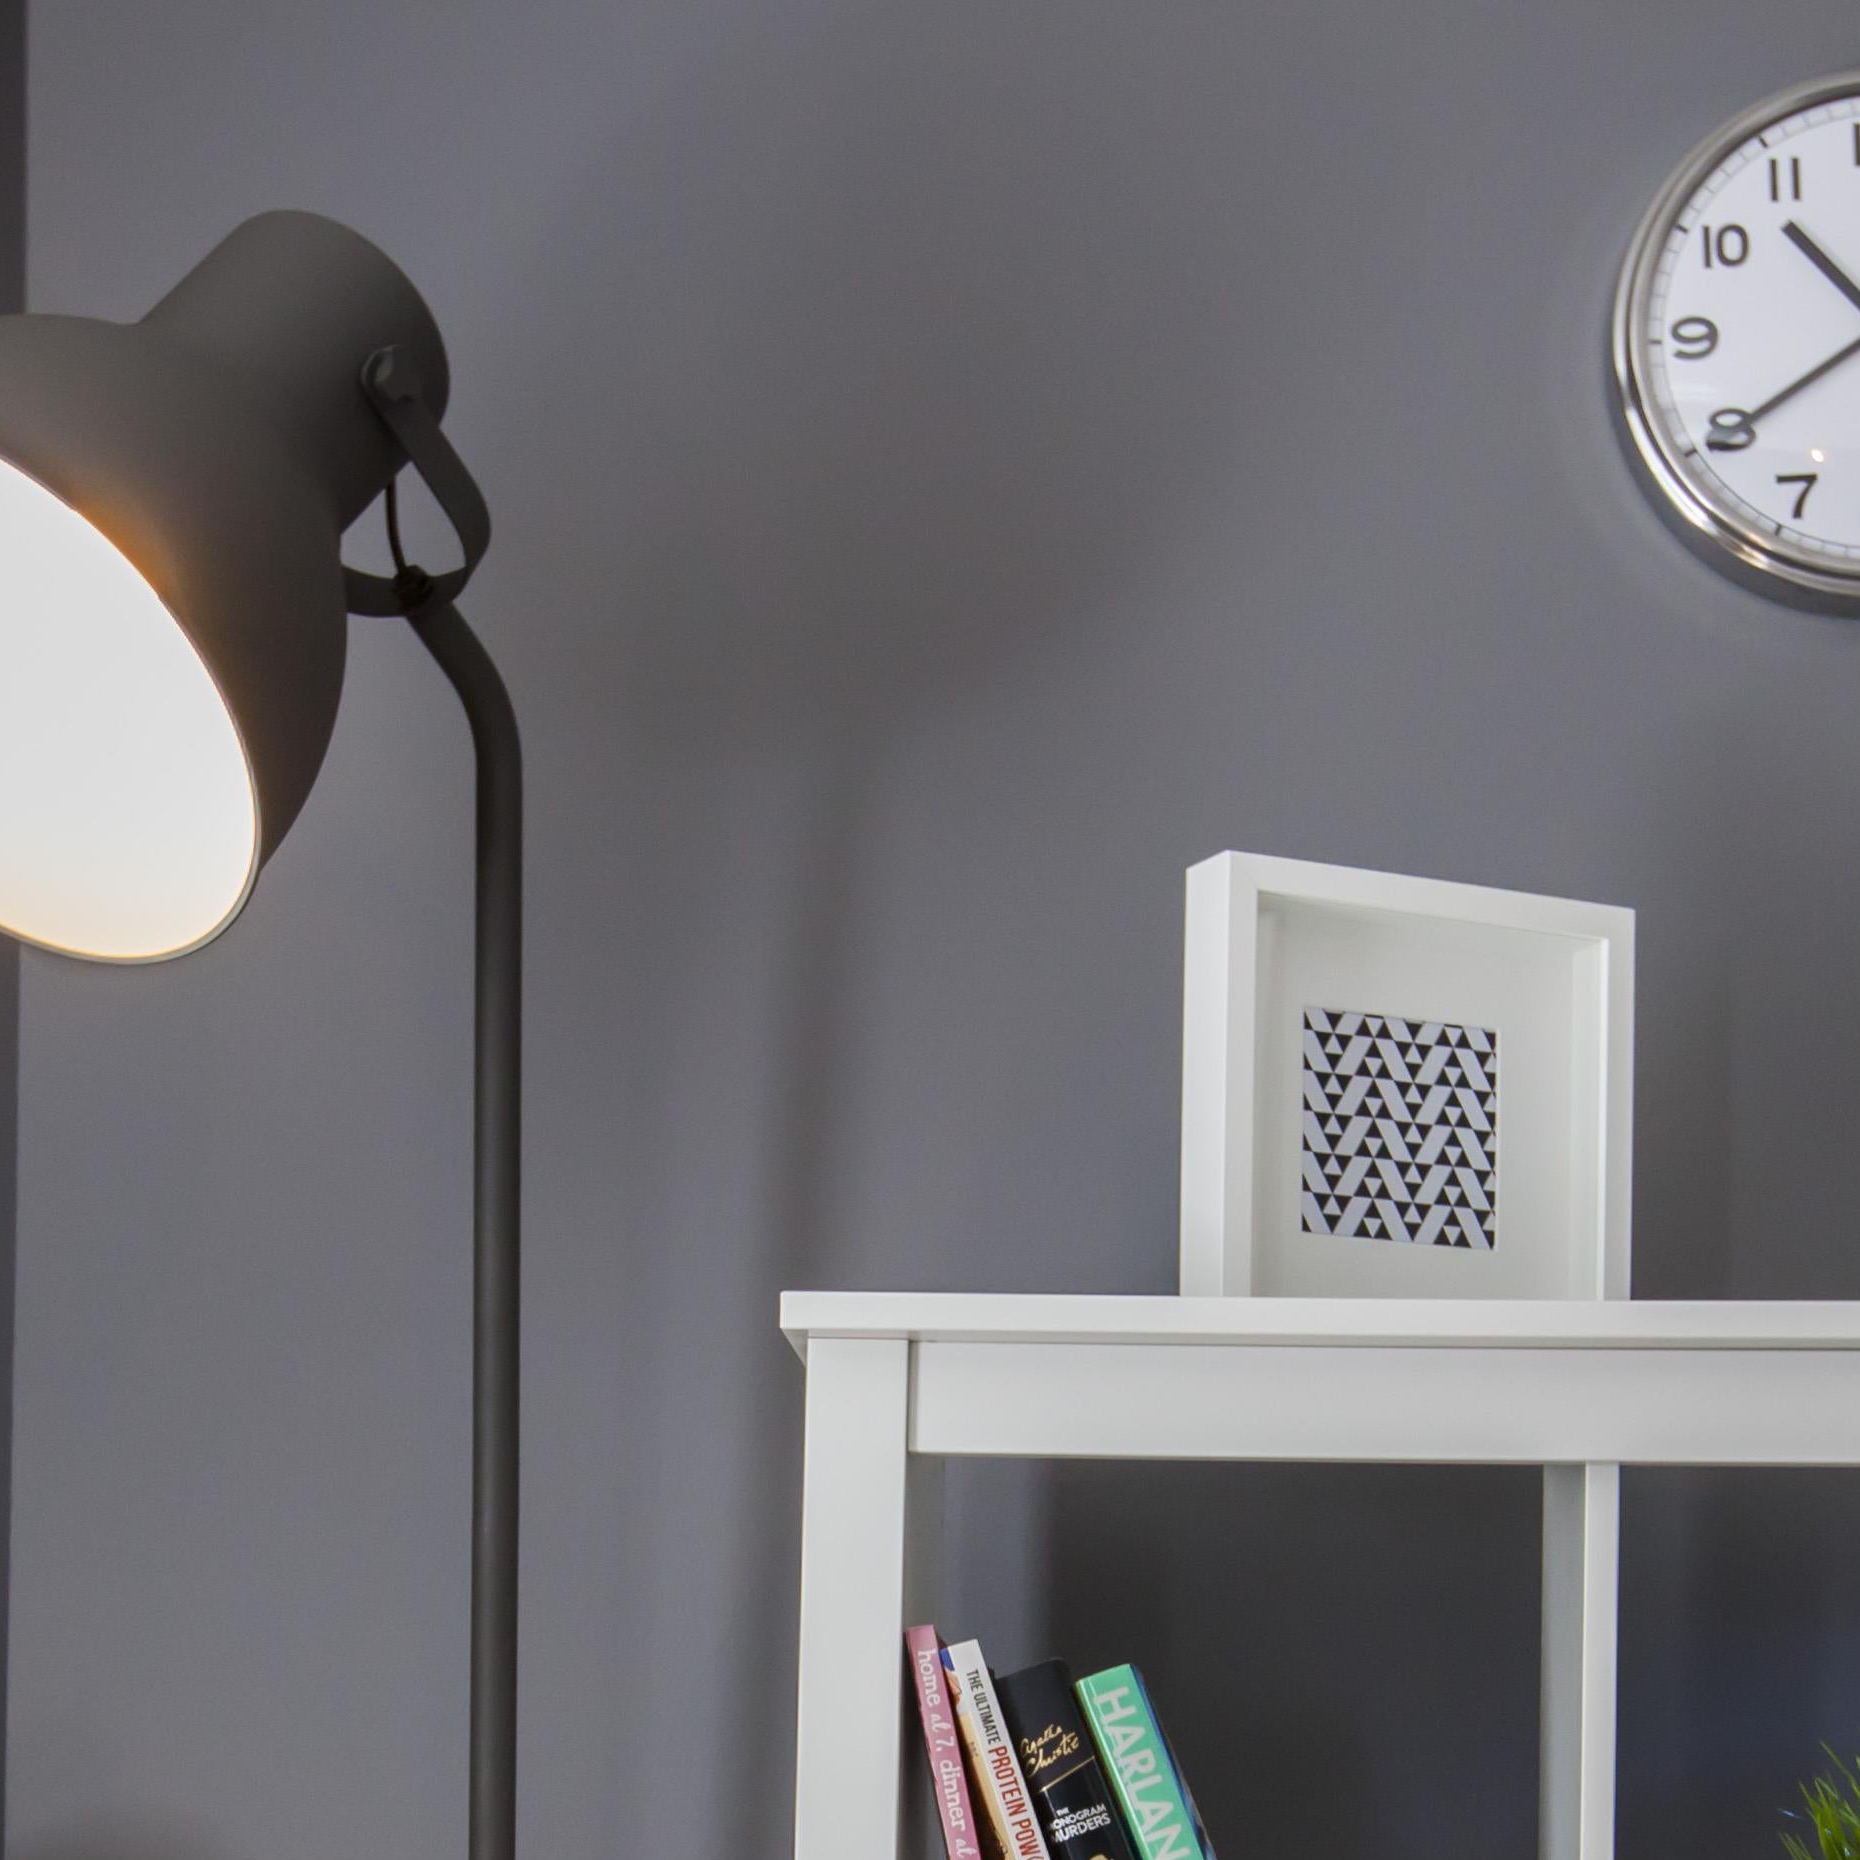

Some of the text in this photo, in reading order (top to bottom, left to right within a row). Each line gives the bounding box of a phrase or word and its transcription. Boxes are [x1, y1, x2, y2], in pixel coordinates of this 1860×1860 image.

[1769, 157, 1802, 202] 11
[1702, 224, 1750, 268] 10
[1670, 316, 1719, 360] 9
[1705, 408, 1756, 452] 8
[1775, 473, 1818, 519] 7
[965, 1669, 985, 1691] THE
[917, 1648, 940, 1706] home
[939, 1760, 967, 1833] dinner
[974, 1692, 1001, 1745] ULTIMATE
[989, 1745, 1028, 1817] PROTEIN
[1056, 1806, 1071, 1816] THE
